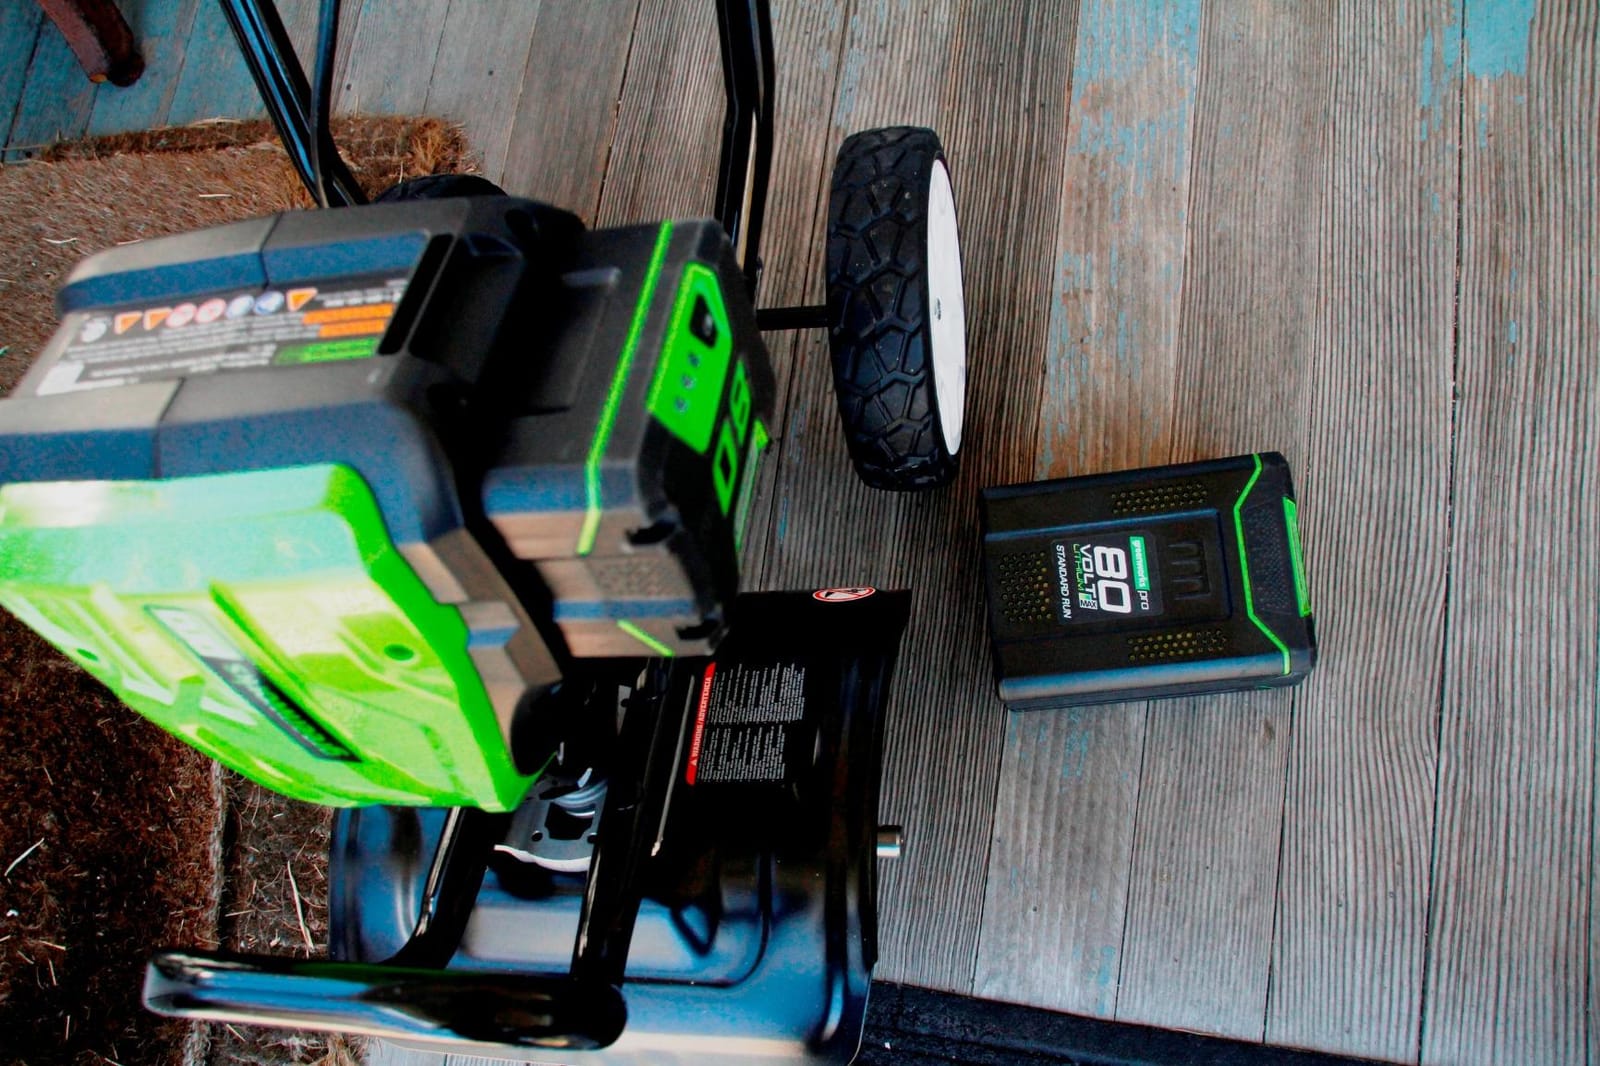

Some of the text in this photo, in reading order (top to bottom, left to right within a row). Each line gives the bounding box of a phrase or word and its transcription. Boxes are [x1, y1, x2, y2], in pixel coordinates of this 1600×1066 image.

[1056, 544, 1072, 619] STANDARD RUN
[1073, 543, 1084, 591] LITHIUM
[1080, 543, 1097, 599] VOLT
[1093, 545, 1131, 614] 80
[1134, 540, 1149, 610] greenworks pro
[1081, 600, 1097, 609] MAX
